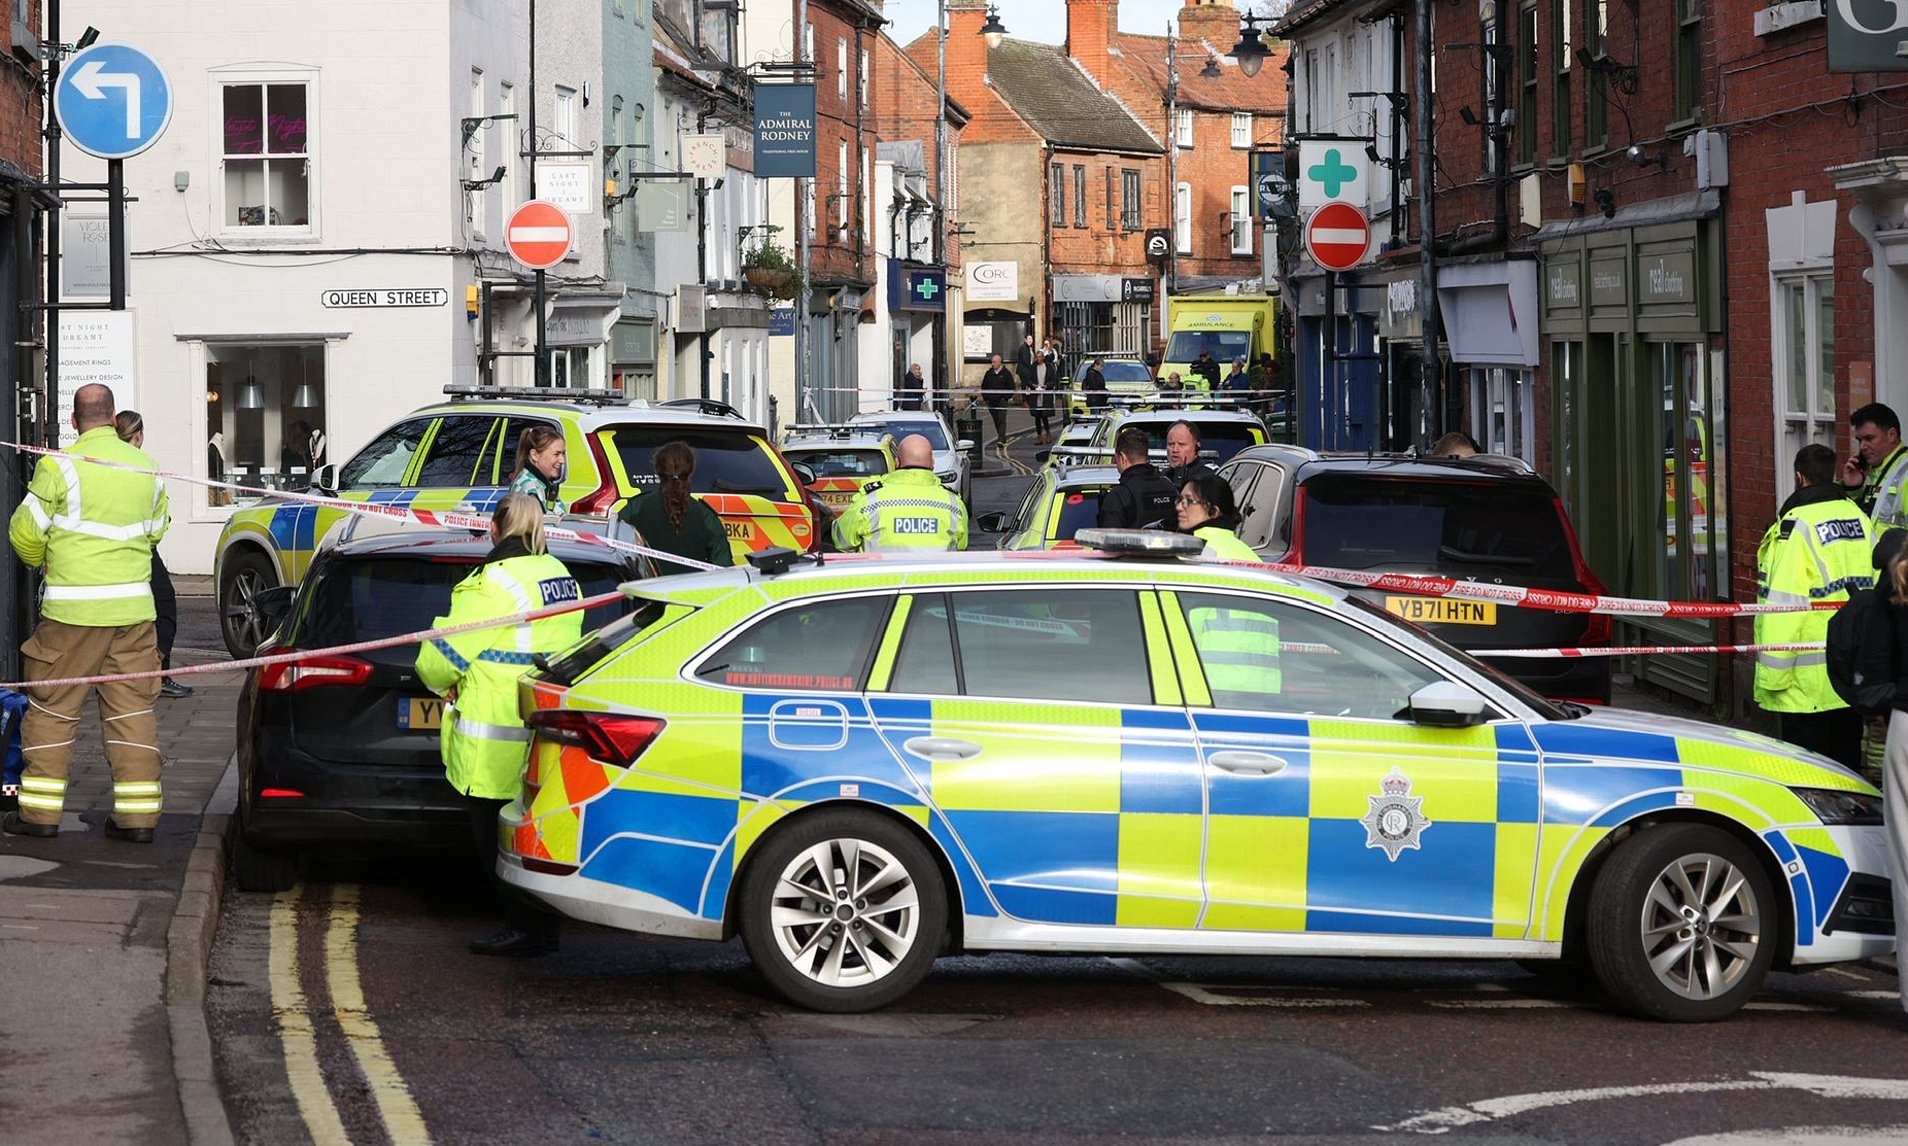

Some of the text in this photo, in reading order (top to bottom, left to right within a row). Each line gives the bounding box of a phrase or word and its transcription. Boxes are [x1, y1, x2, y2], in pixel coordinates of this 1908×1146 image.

[758, 119, 813, 129] ADMIRAL
[761, 131, 811, 141] RODNEY
[329, 290, 440, 305] QUEEN STREET
[64, 373, 98, 381] JEWELLERY
[99, 373, 124, 381] DESIGN
[60, 432, 78, 440] GOLD
[1153, 496, 1170, 504] POLICE
[369, 504, 382, 513] NOT
[384, 506, 408, 517] CROSS
[444, 514, 469, 527] POLICE
[895, 518, 936, 533] POLICE
[725, 523, 750, 538] BKA
[1816, 520, 1864, 542] POLICE
[540, 579, 577, 602] POLICE
[1399, 600, 1484, 621] YB71 HTN
